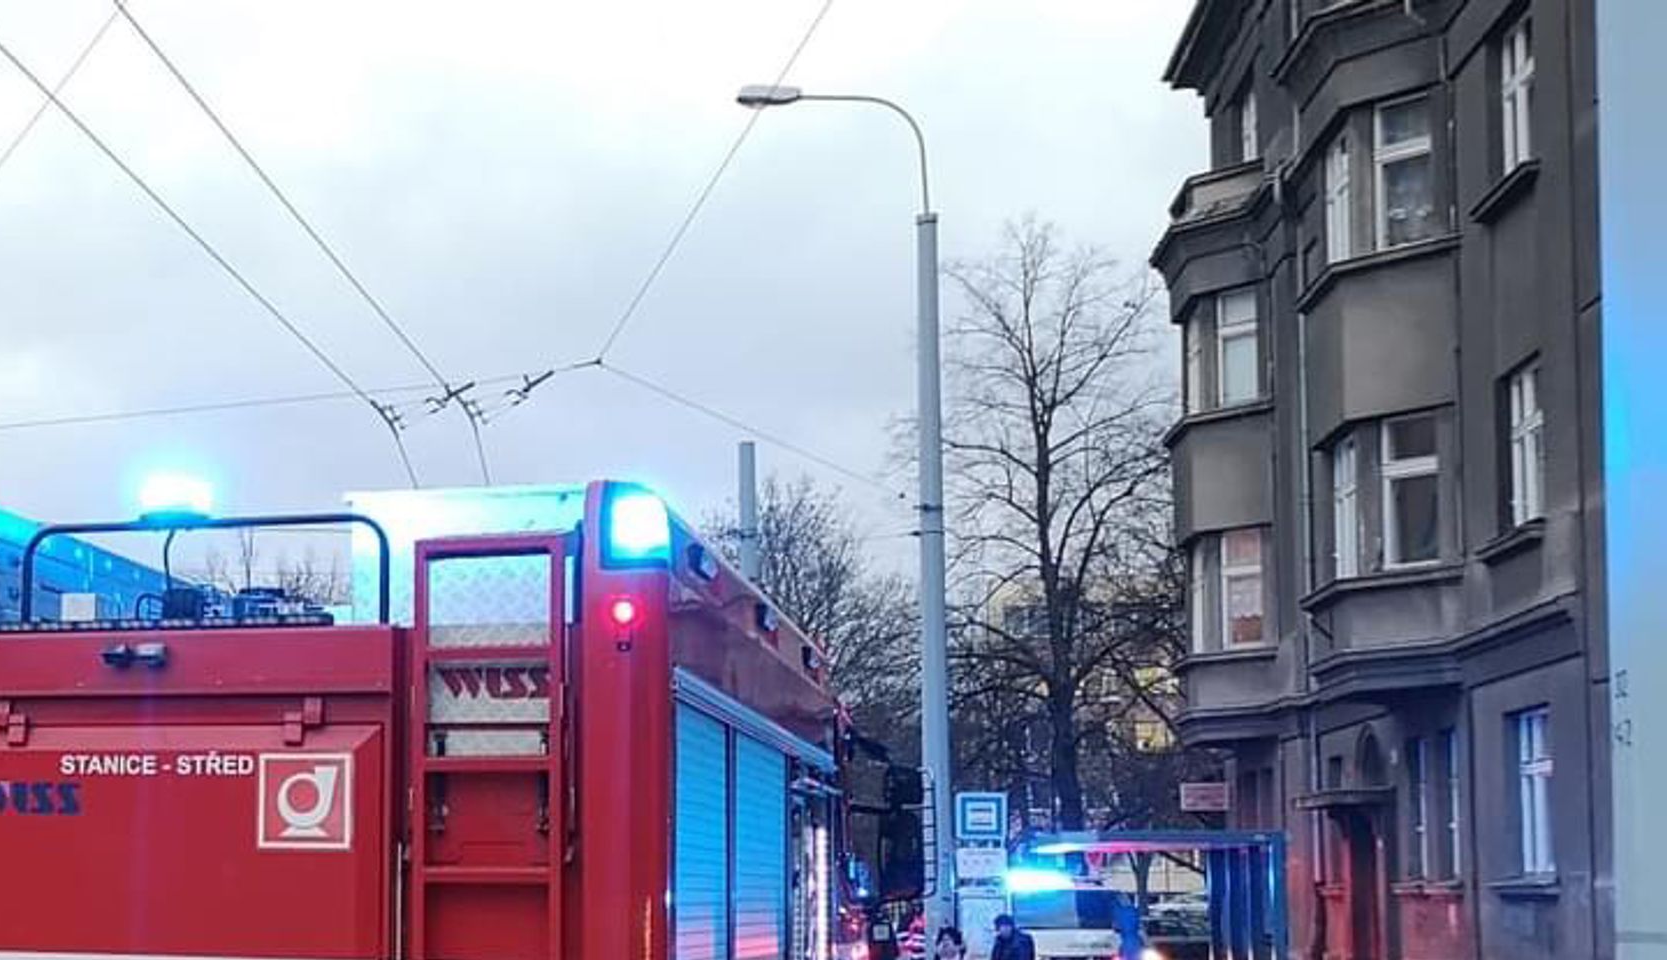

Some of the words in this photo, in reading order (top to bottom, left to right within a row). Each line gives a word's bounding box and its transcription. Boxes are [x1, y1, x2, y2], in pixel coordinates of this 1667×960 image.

[435, 666, 550, 698] WISS
[59, 754, 157, 775] STANICE
[176, 750, 255, 775] STŘED
